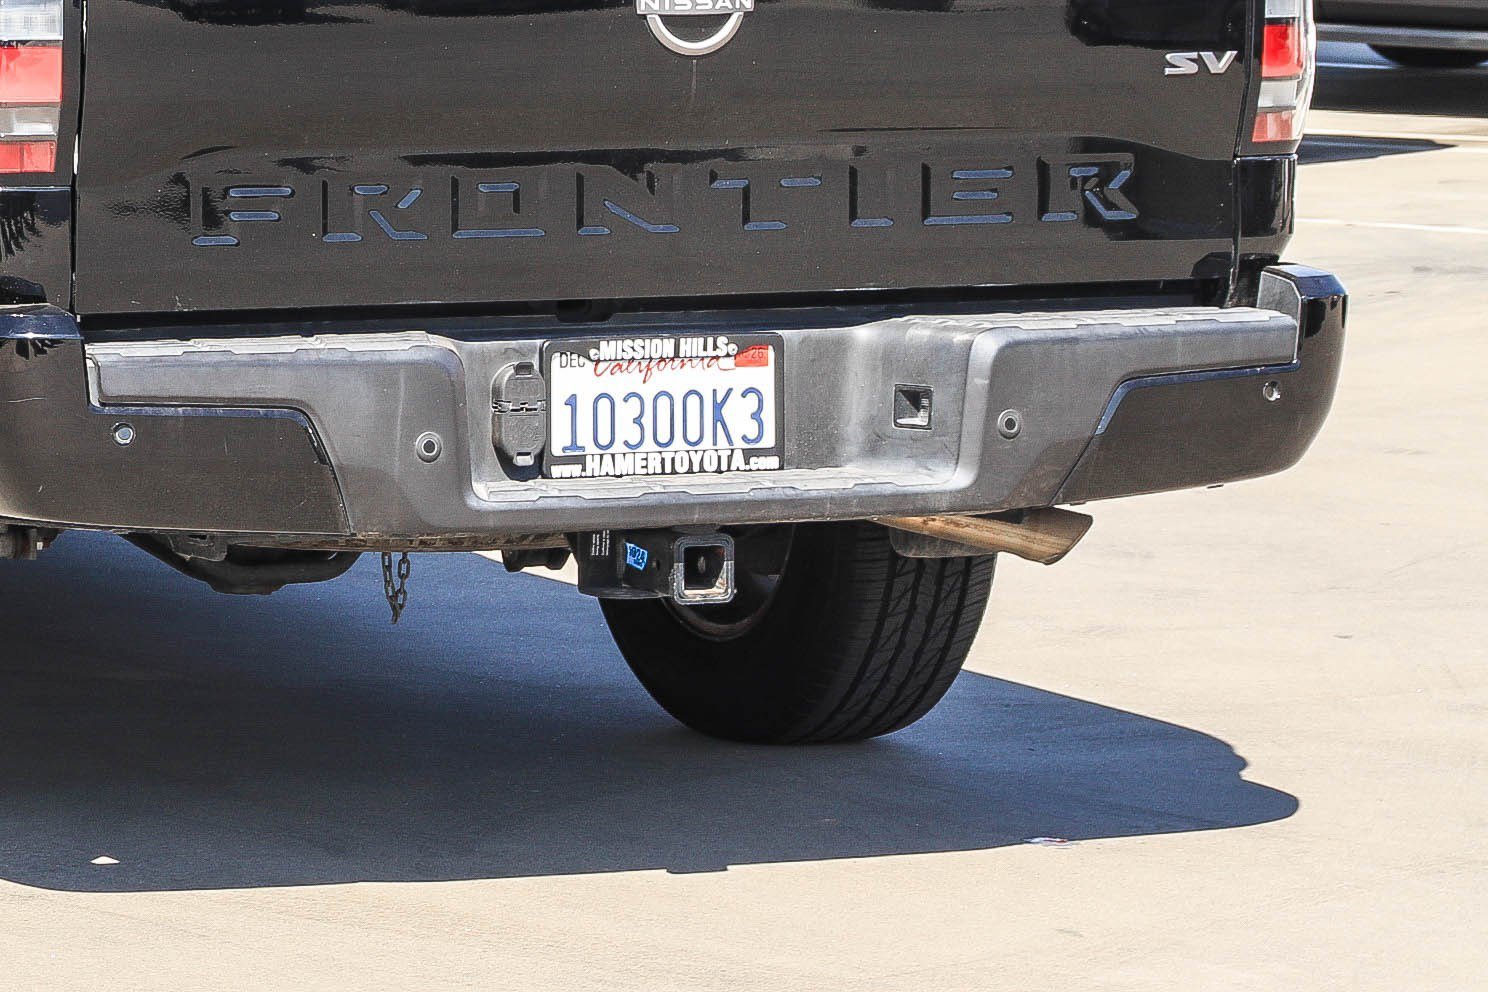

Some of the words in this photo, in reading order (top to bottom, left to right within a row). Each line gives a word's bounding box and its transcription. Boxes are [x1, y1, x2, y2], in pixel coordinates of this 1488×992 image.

[1164, 50, 1238, 75] SV
[190, 155, 1140, 247] FRONTIER
[559, 352, 586, 369] DEC
[599, 338, 675, 359] MISSION
[679, 336, 729, 357] HILLS
[562, 386, 764, 454] 10300K3
[550, 449, 780, 479] www.HAMERTOYOTA.com
